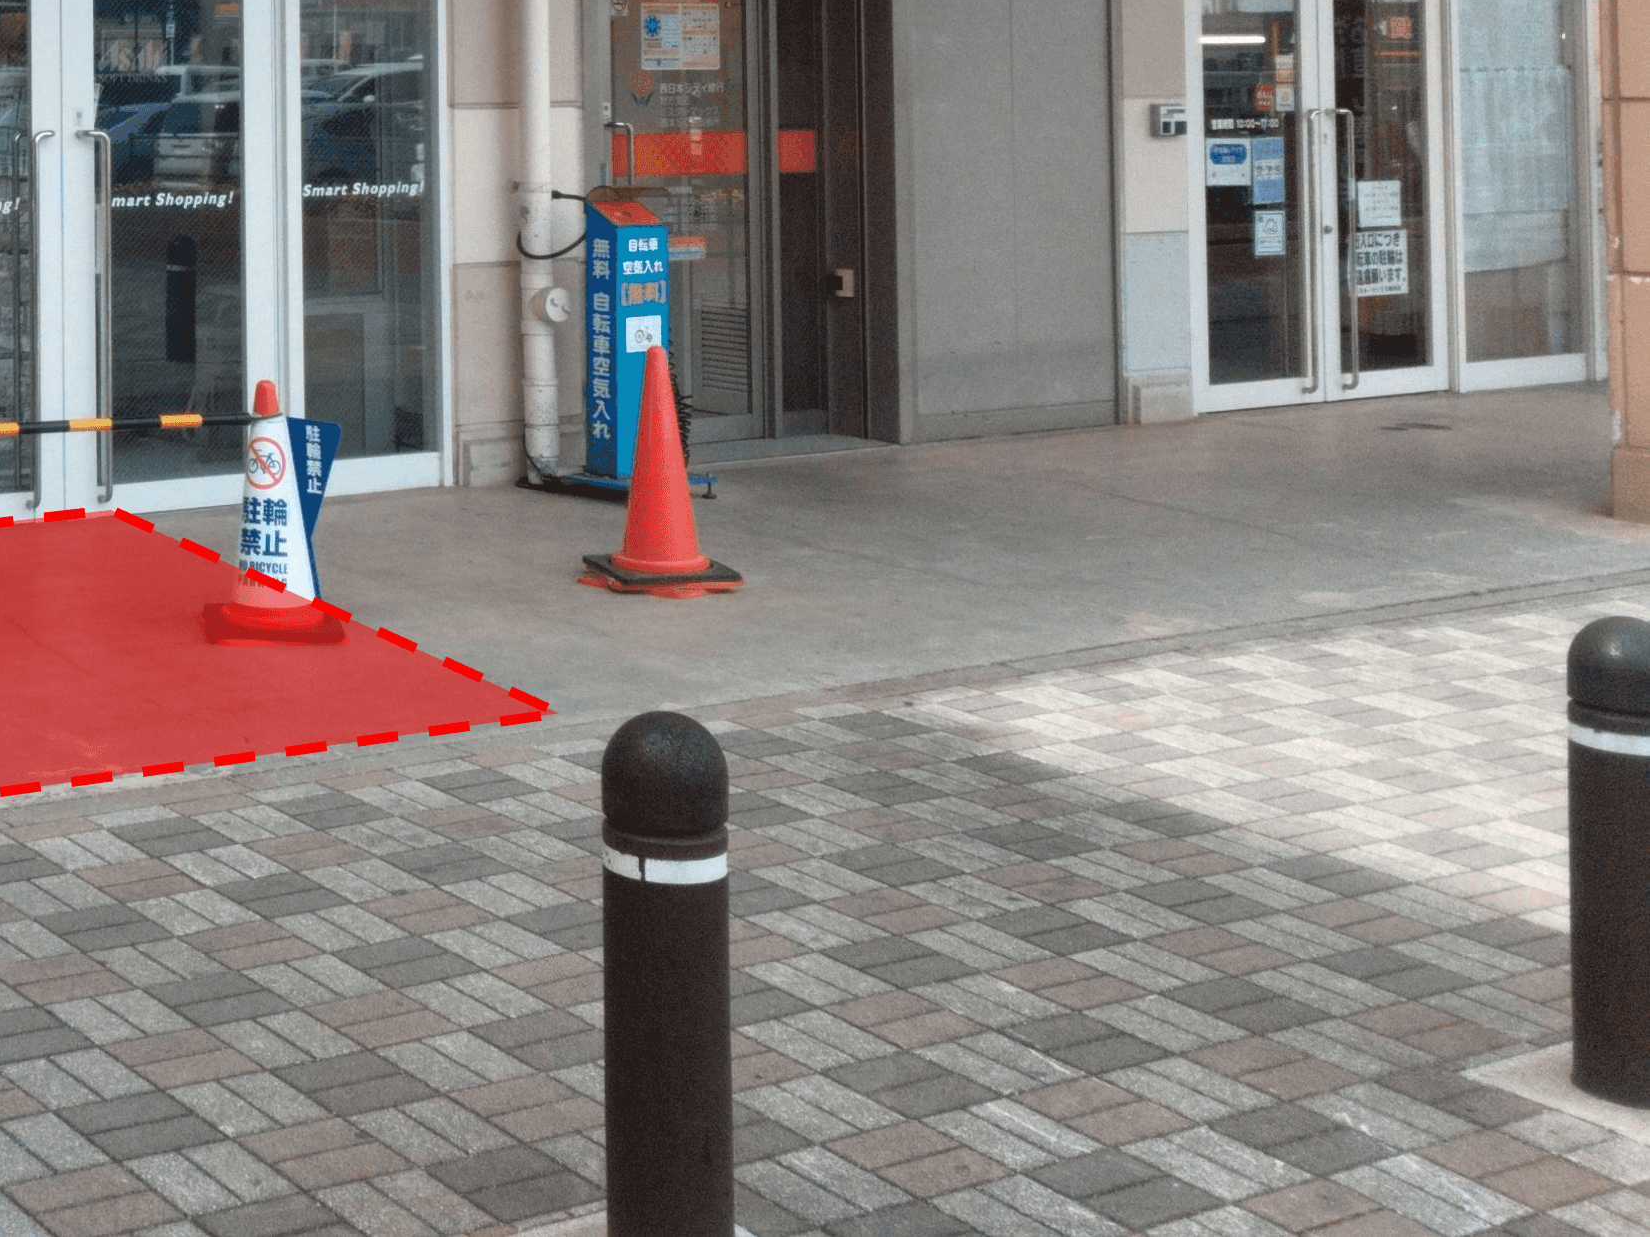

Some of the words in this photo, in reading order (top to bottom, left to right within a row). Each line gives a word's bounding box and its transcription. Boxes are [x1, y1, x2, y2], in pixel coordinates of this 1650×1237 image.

[111, 195, 151, 208] mart
[155, 190, 235, 209] Shopping!
[302, 183, 348, 197] Smart
[352, 180, 425, 198] Shopping!
[593, 238, 611, 280] 無料
[628, 238, 659, 252] 自転車
[305, 424, 323, 494] 駐輪禁止
[242, 496, 287, 527] 駐輪
[240, 527, 288, 558] 禁止
